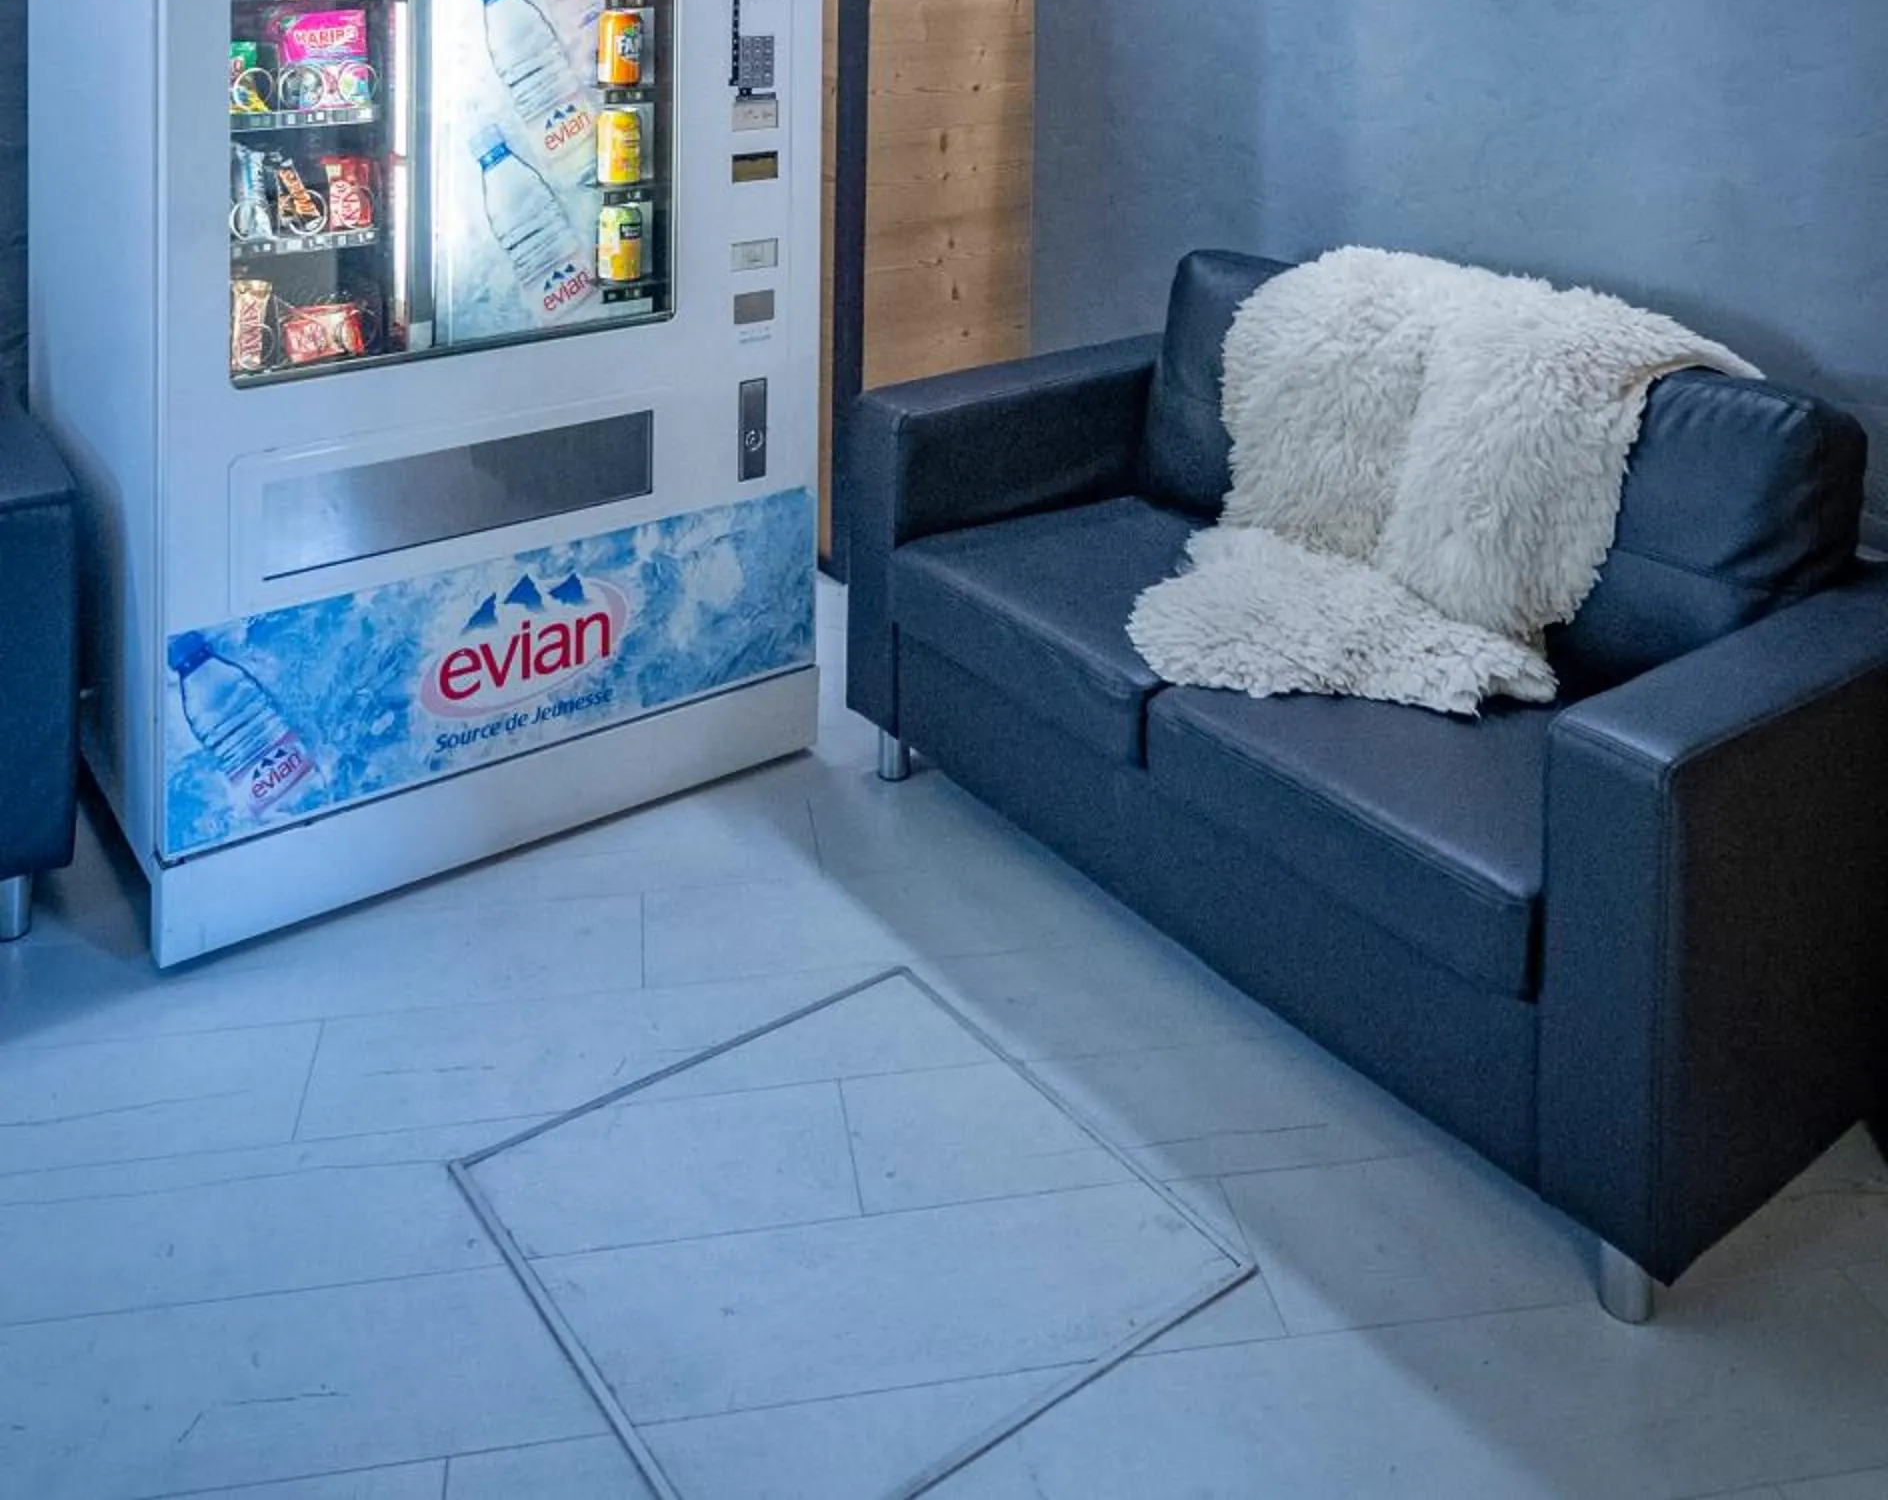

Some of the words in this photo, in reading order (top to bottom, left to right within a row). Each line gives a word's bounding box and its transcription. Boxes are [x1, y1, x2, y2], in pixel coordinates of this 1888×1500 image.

[545, 111, 592, 151] evian
[543, 270, 589, 311] evian
[439, 612, 610, 700] evian
[436, 719, 500, 753] Source
[505, 712, 529, 731] de
[531, 687, 613, 724] Jeunesse
[252, 751, 302, 798] evian
